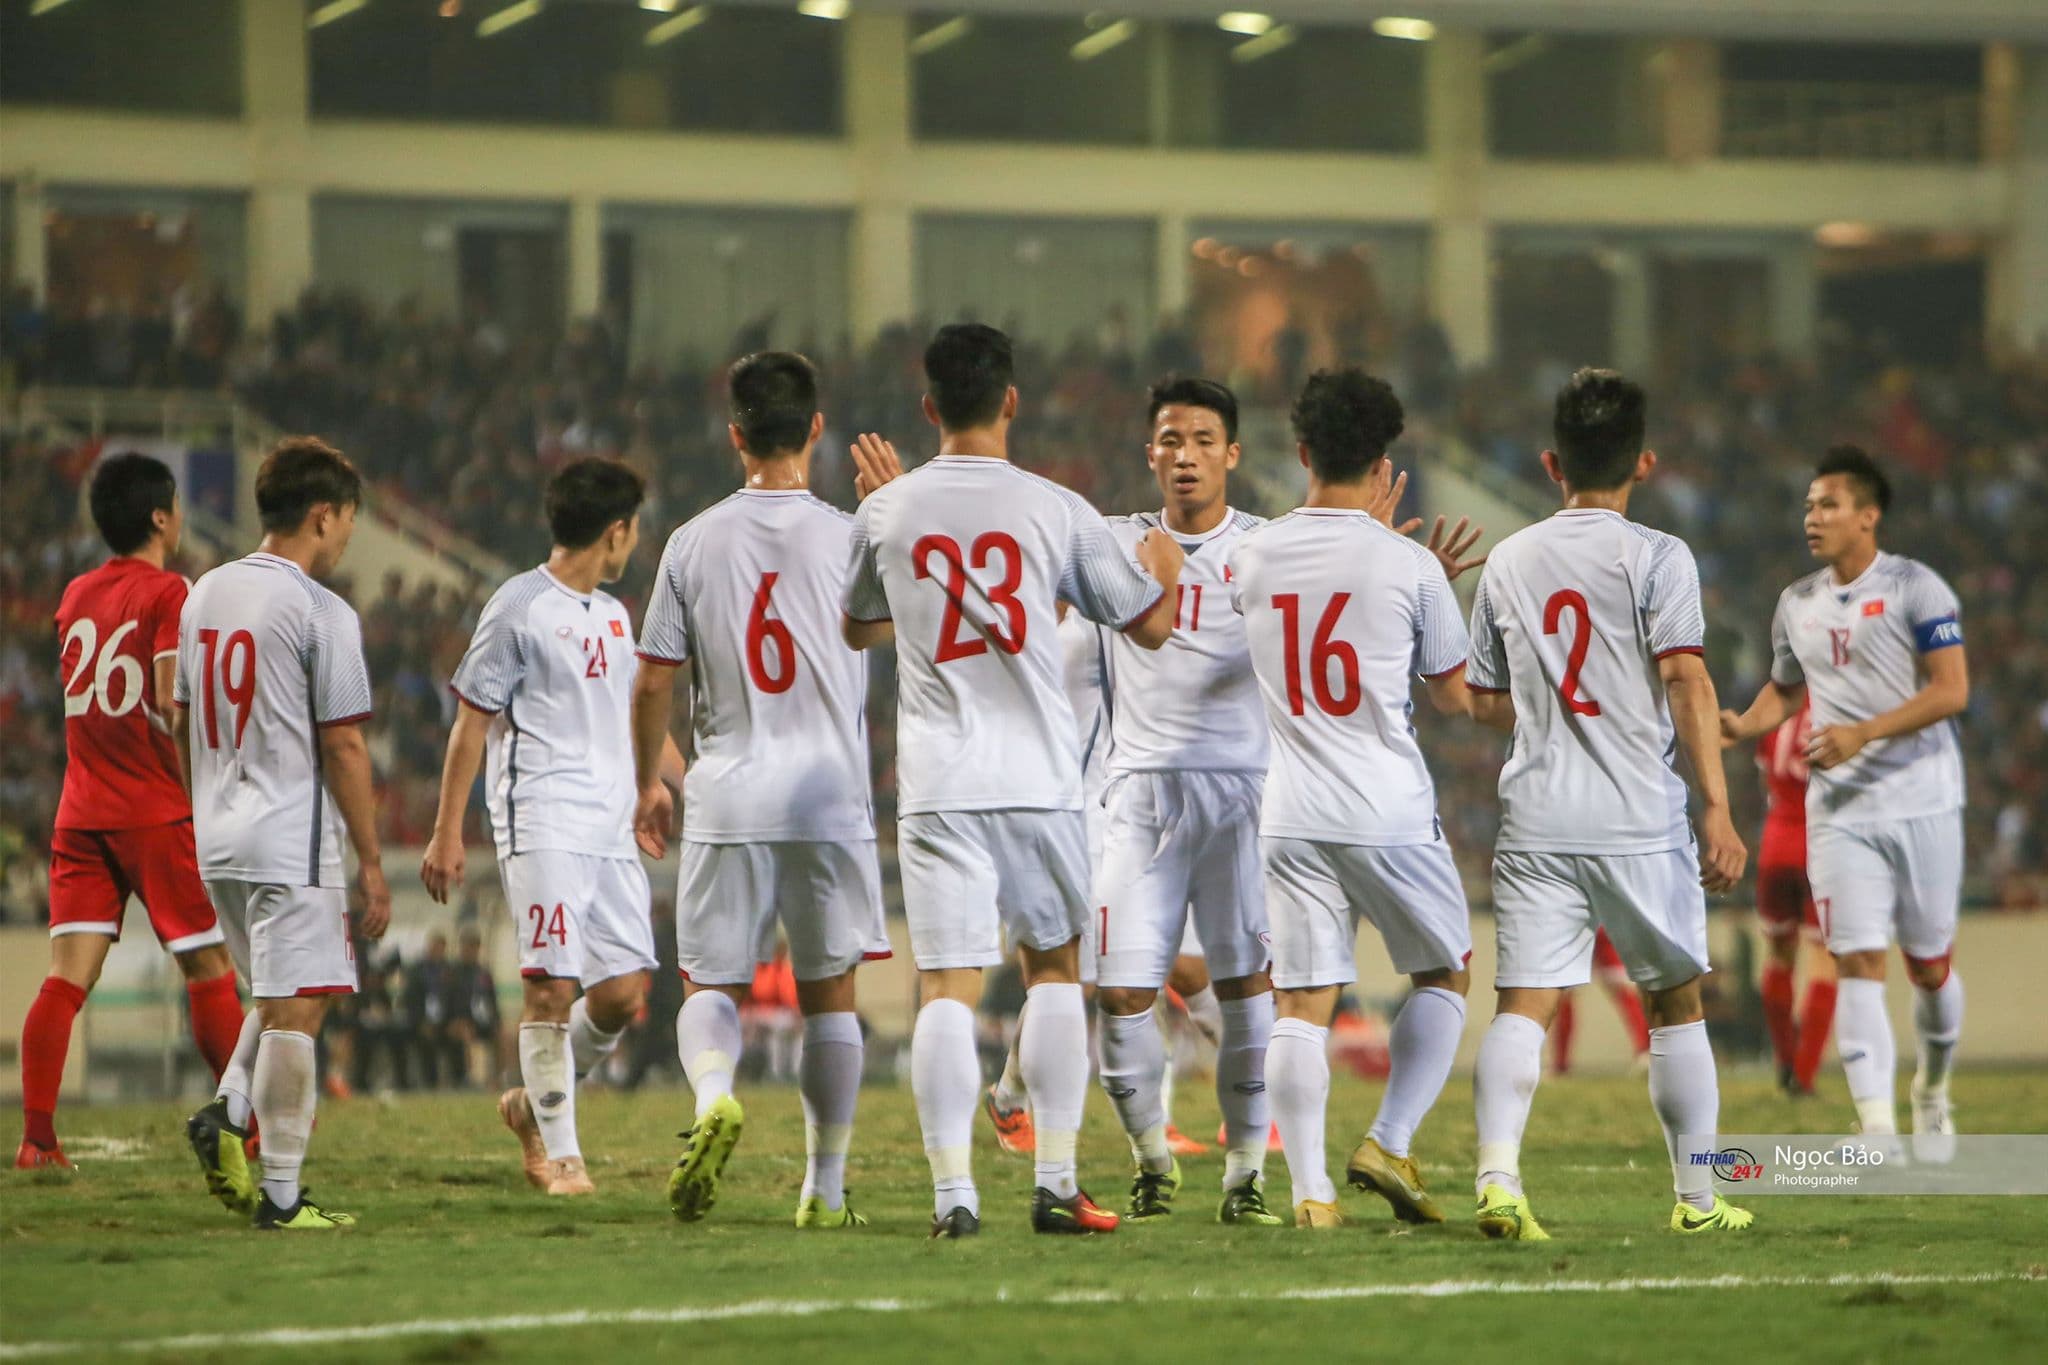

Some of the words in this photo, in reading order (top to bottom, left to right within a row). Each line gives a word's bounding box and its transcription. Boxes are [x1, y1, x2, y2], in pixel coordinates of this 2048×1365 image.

[583, 636, 607, 679] 24
[745, 571, 797, 694] 6
[911, 530, 1028, 665] 23
[1270, 591, 1362, 717] 16
[1542, 588, 1601, 717] 2
[63, 618, 144, 718] 26
[197, 628, 256, 749] 19
[528, 903, 567, 949] 24
